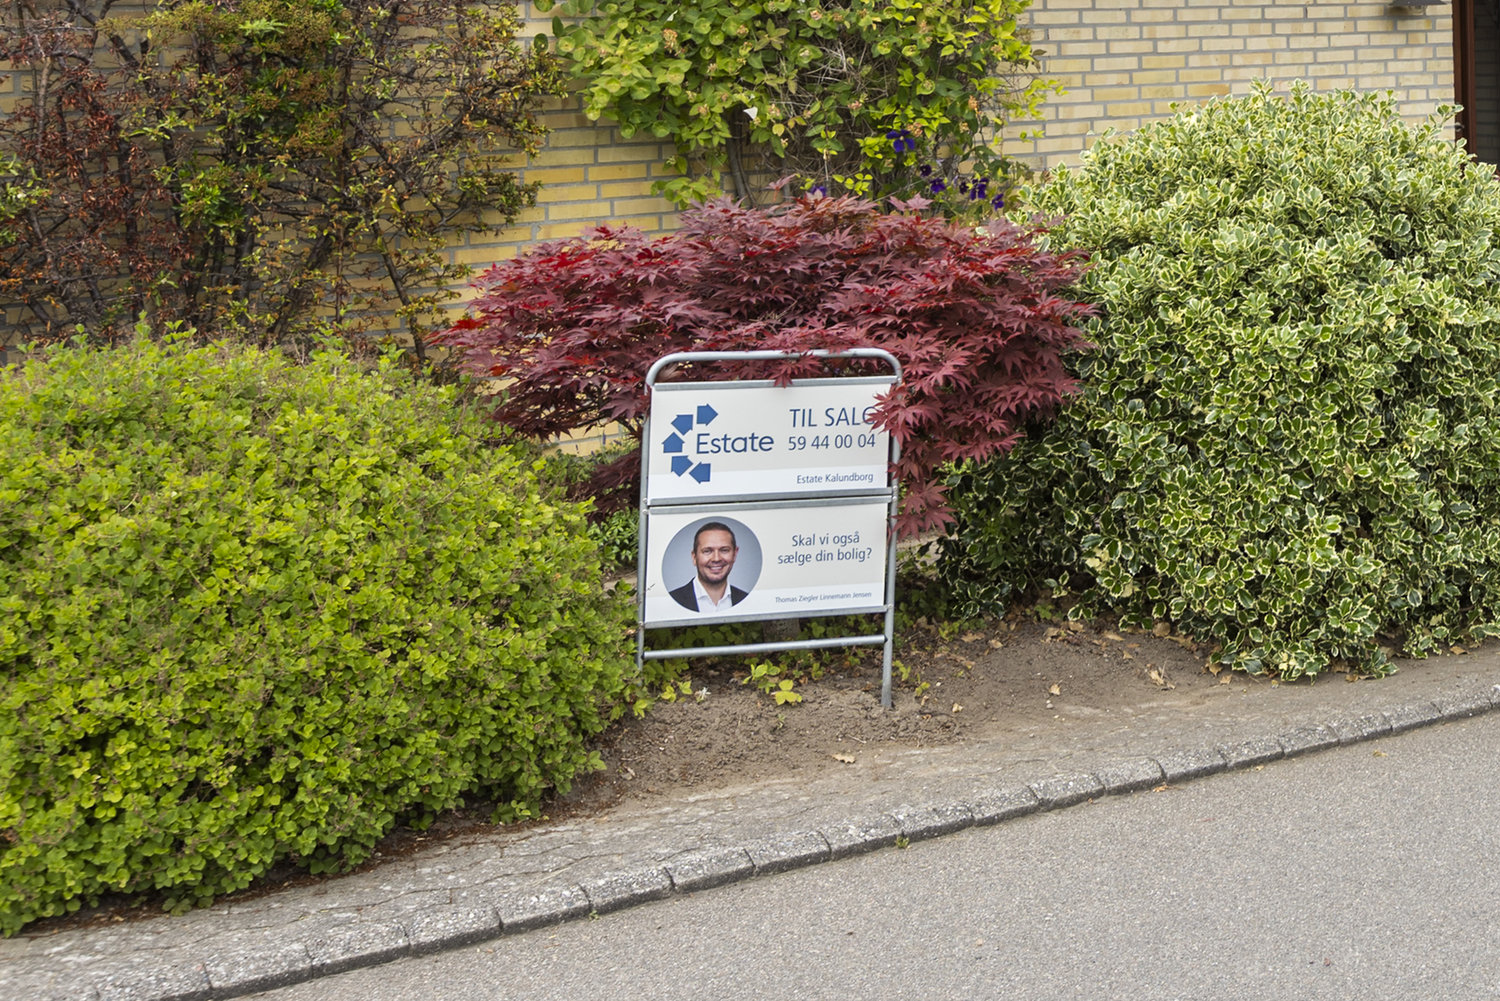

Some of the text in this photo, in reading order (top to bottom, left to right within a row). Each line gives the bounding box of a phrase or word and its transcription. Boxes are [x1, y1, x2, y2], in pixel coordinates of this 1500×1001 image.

[789, 408, 817, 428] TIL
[696, 432, 774, 454] Estate
[788, 433, 876, 451] 59 44 00 04
[796, 472, 874, 484] Estate Kalundborg
[791, 531, 860, 547] Skal vi også
[777, 547, 873, 566] sælge din bolig?
[775, 596, 798, 604] Thomas
[798, 594, 819, 603] Ziegler
[852, 591, 872, 599] Jensen
